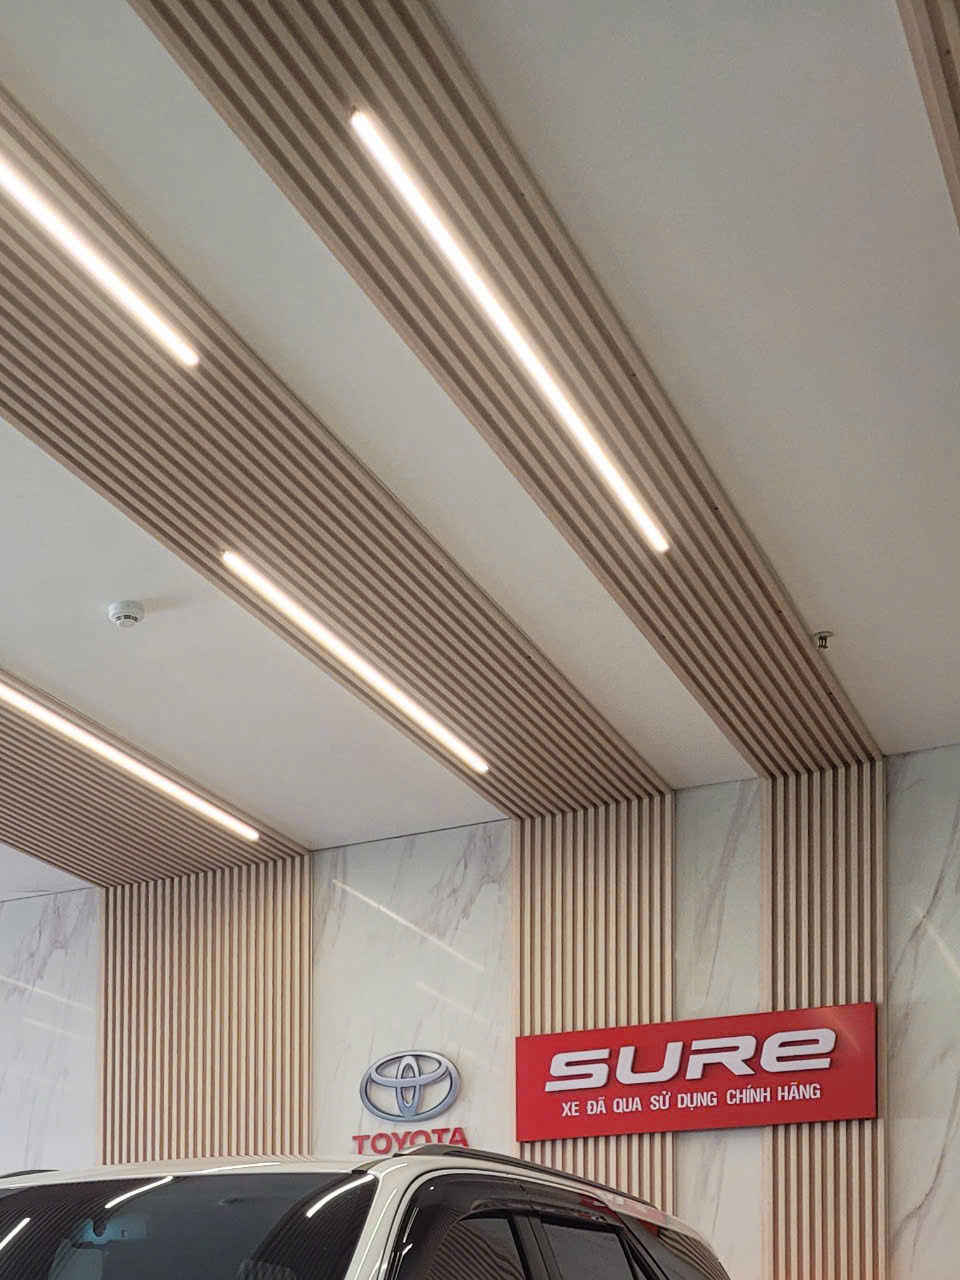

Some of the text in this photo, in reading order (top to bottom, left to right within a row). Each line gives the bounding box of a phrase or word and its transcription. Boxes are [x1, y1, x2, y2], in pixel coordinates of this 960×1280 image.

[562, 1081, 820, 1117] XE ĐÃ QUA SỬ DỤNG CHÍNH HÃNG
[352, 1127, 469, 1155] TOYOTA
